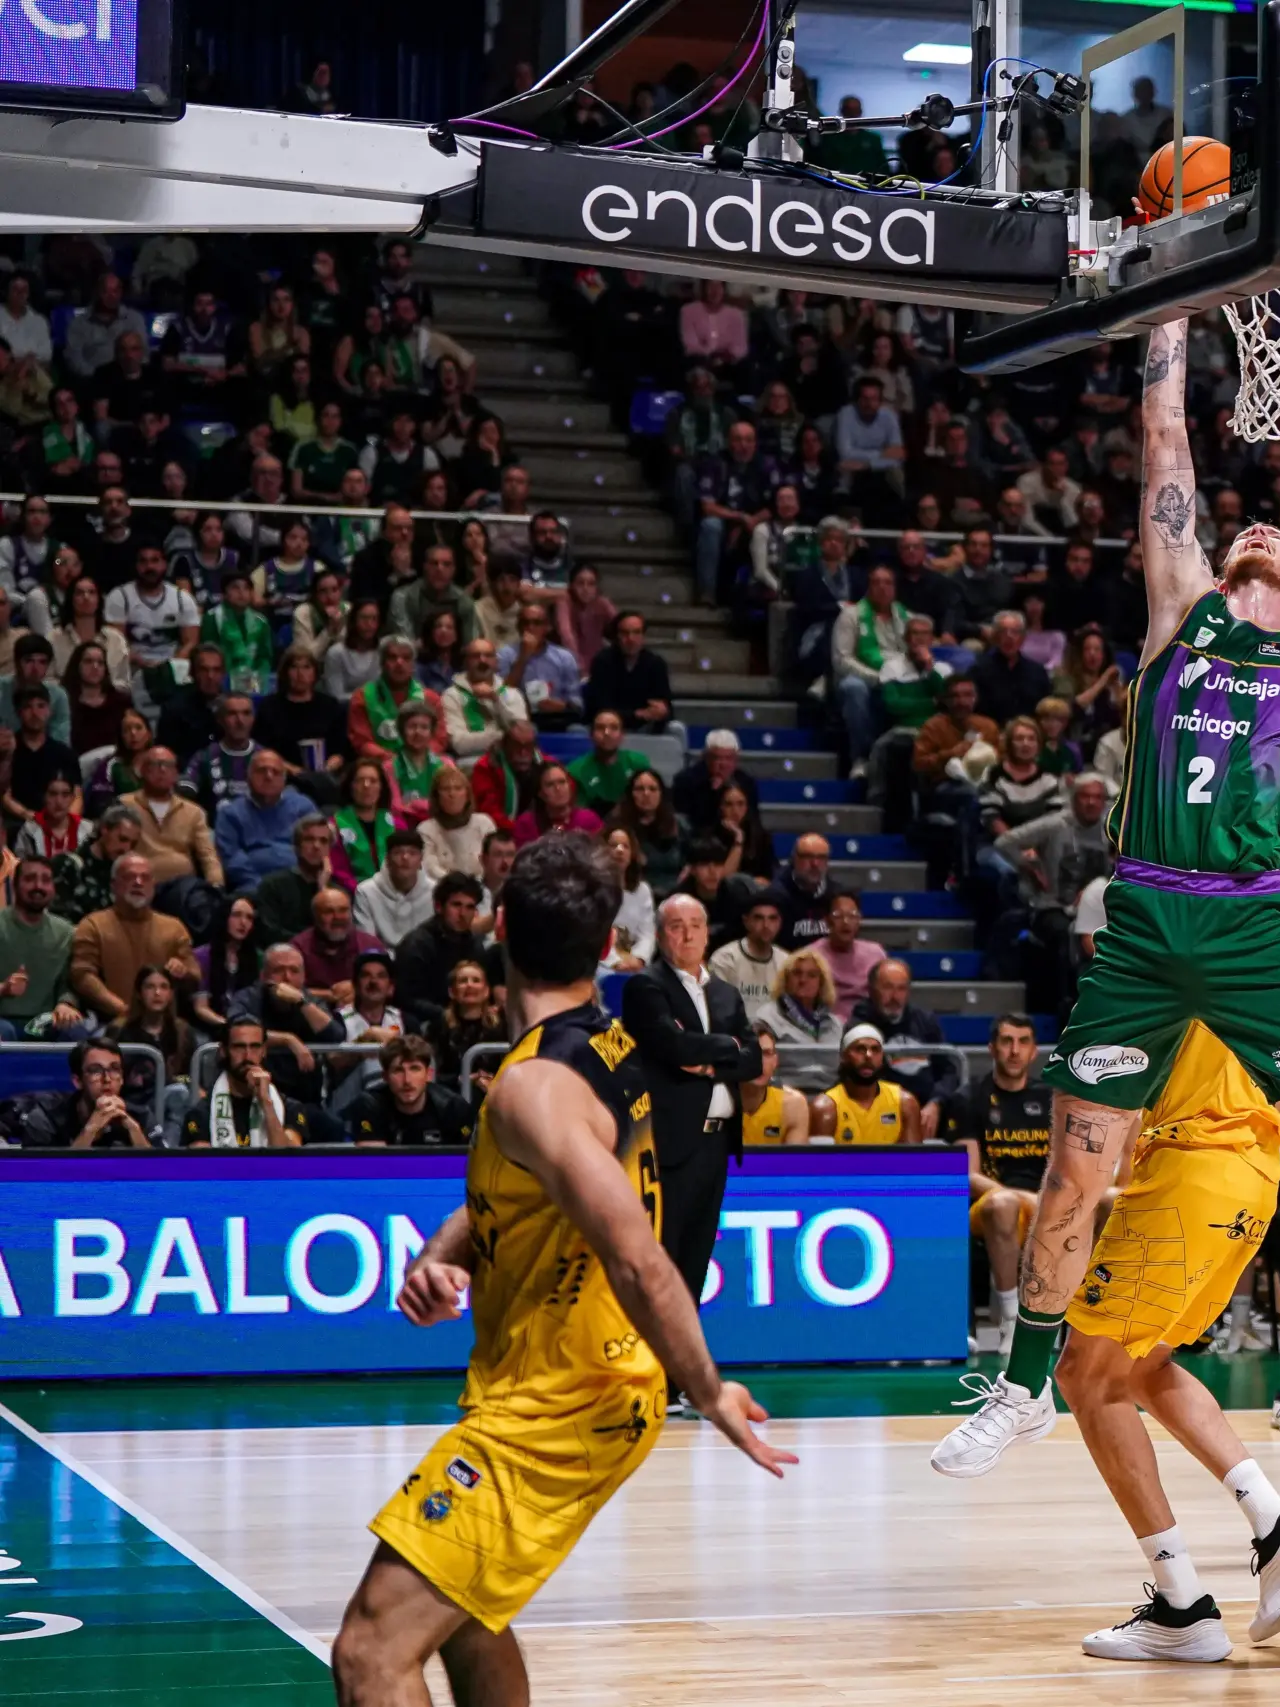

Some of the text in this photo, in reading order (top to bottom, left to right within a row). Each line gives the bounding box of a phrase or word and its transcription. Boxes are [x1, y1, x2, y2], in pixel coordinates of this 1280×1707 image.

[581, 179, 936, 267] endesa
[1203, 673, 1280, 701] Unicaja
[1187, 756, 1216, 804] 2
[1074, 1047, 1145, 1070] famadesa
